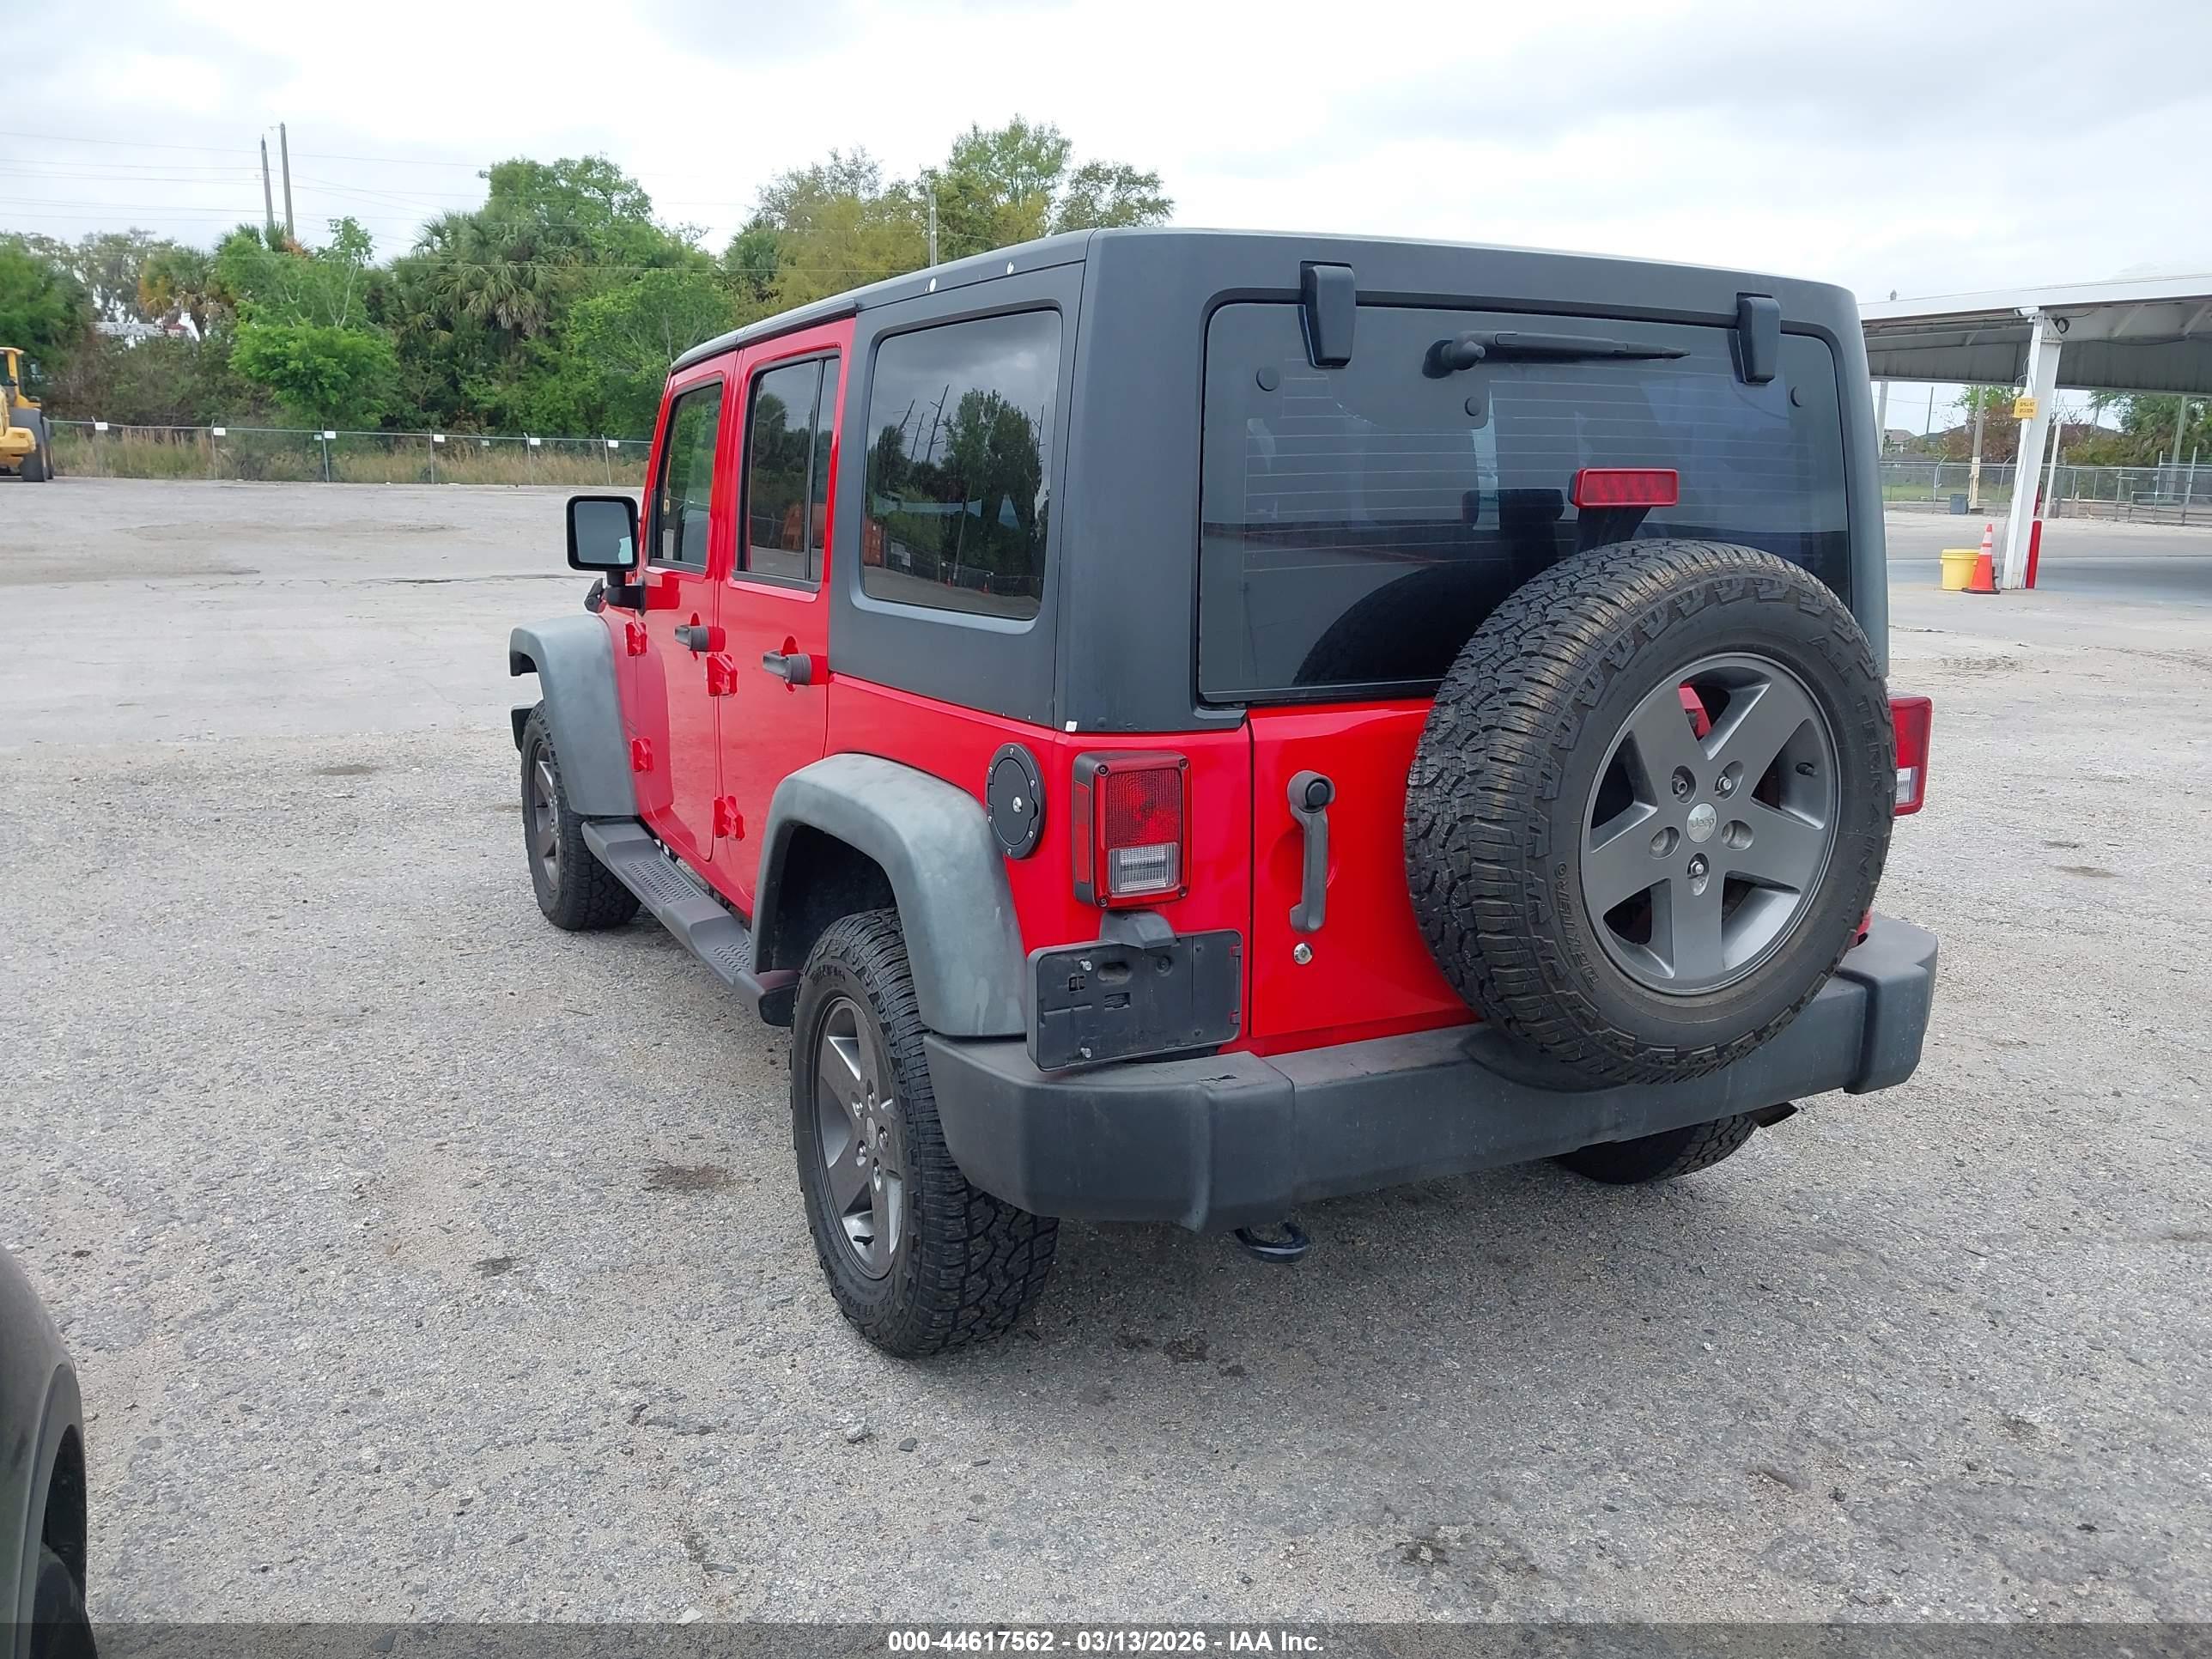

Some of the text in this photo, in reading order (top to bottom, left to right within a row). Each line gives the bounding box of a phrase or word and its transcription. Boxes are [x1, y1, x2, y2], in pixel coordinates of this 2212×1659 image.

[1807, 635, 1882, 874] ALL TERRAIN
[1692, 817, 1714, 829] Jeep
